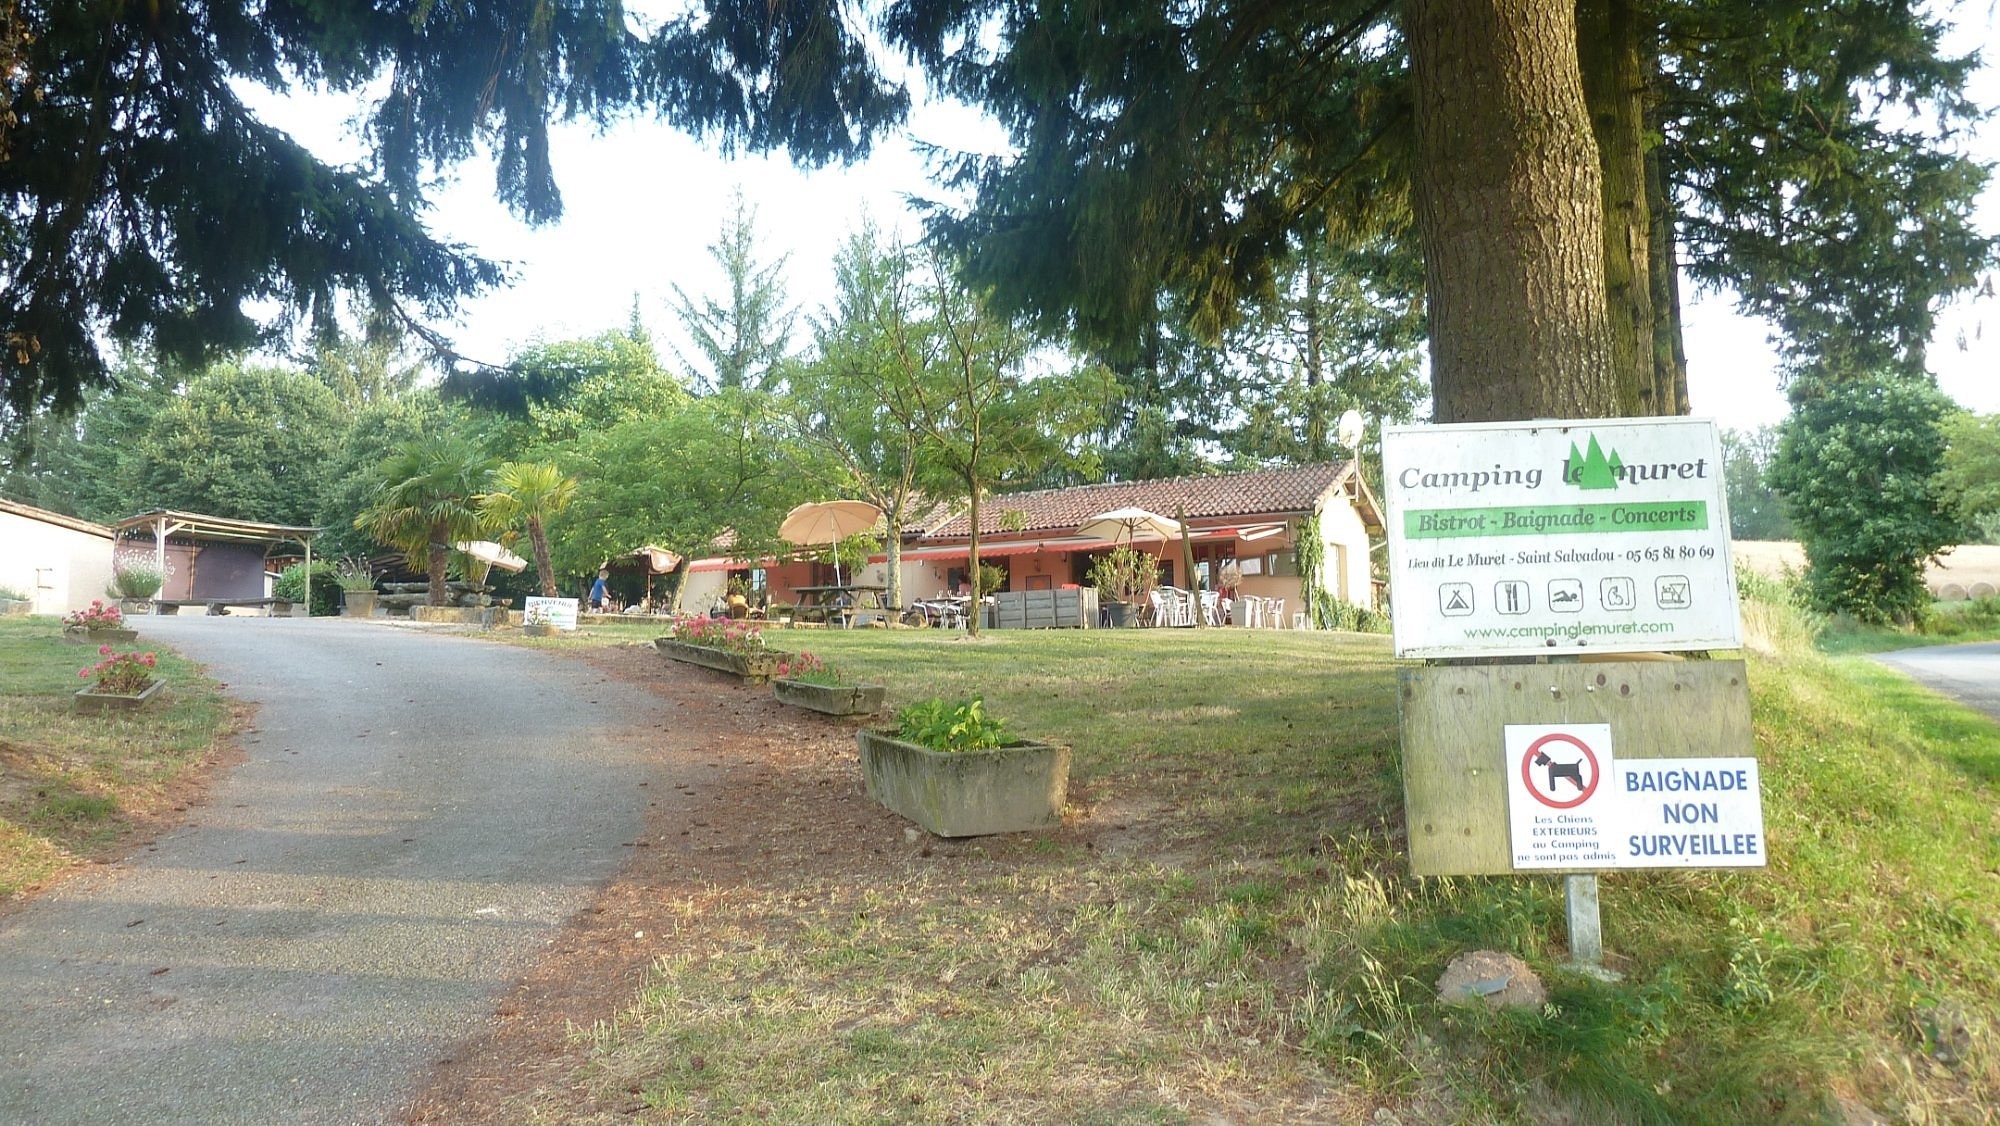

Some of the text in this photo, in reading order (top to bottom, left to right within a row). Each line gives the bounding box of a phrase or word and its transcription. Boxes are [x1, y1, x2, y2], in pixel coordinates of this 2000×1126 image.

[1399, 457, 1708, 492] Camping le muret
[1419, 513, 1487, 532] Bistrot
[1502, 508, 1595, 531] Baignade
[1611, 507, 1696, 524] Concerts
[1408, 557, 1429, 569] Lieu
[1431, 556, 1445, 568] dit
[1448, 554, 1464, 567] Le
[1467, 553, 1506, 567] Muret
[1517, 549, 1551, 564] Saint
[1554, 547, 1615, 564] Salvadou
[1626, 550, 1642, 563] 05
[1644, 546, 1660, 562] 65
[1662, 545, 1675, 560] 81
[1679, 545, 1696, 561] 80
[1699, 545, 1715, 560] 69
[1464, 621, 1675, 640] www.campinglemuret.com
[1625, 770, 1748, 792] BAIGNADE
[1535, 815, 1593, 824] Les Chiens
[1663, 803, 1719, 824] NON
[1532, 827, 1598, 836] EXTERIEURS
[1551, 839, 1600, 850] Camping
[1629, 834, 1757, 856] SURVEILLEE
[1534, 853, 1557, 861] sont
[1559, 854, 1579, 863] pas
[1583, 851, 1616, 861] admis
